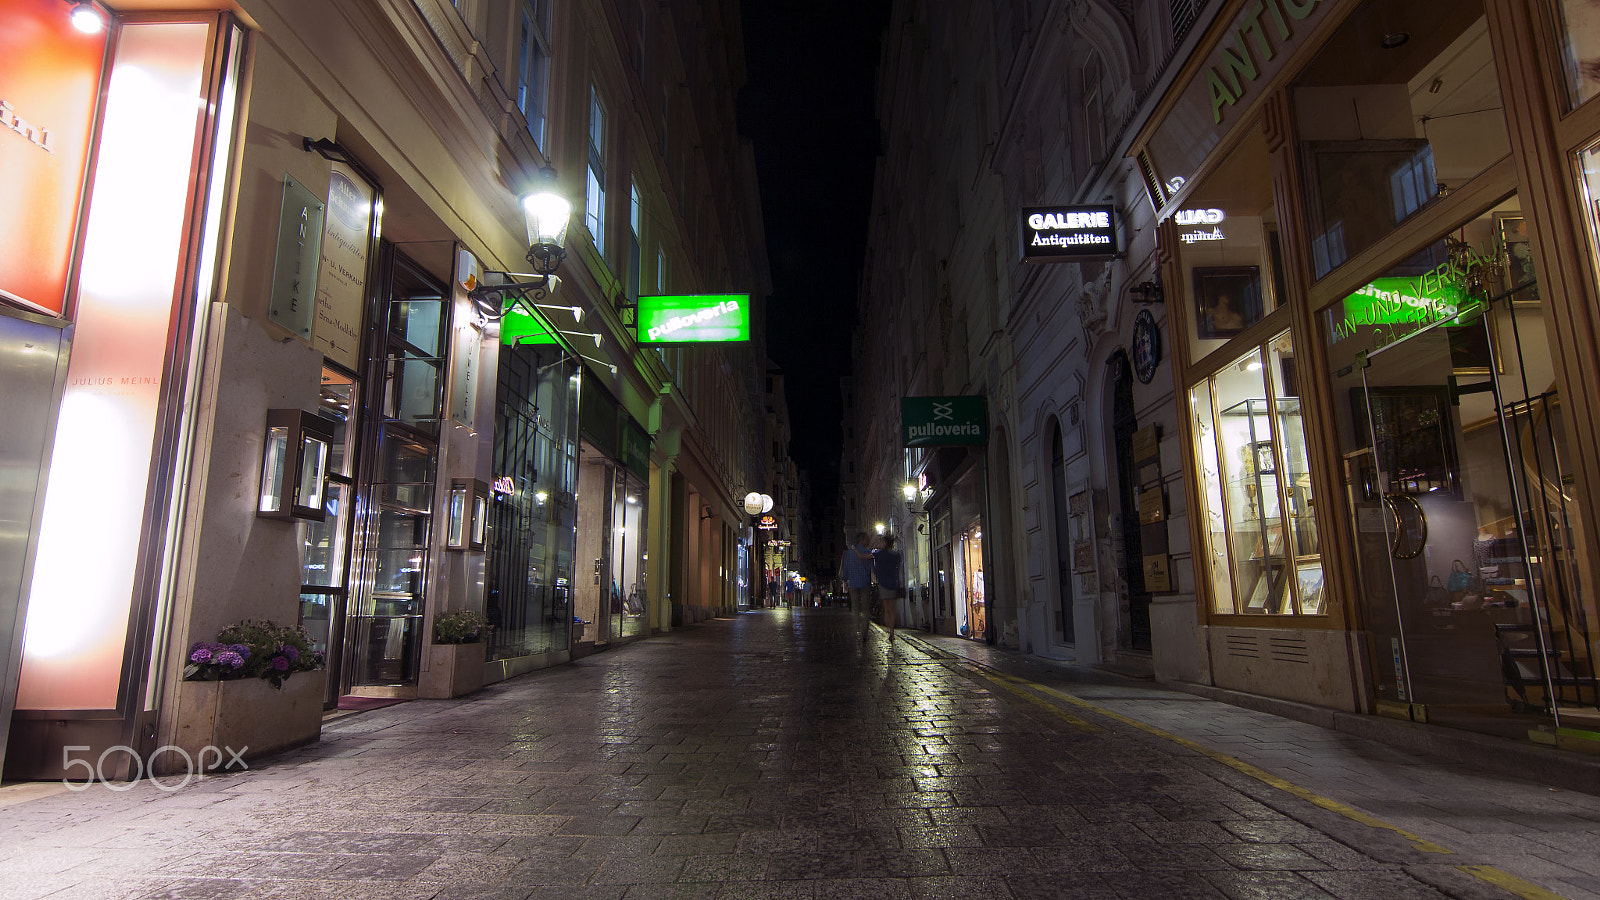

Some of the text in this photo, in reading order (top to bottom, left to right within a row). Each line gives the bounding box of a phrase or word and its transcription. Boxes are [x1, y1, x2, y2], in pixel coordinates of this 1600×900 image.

[1028, 211, 1110, 230] GALERIE
[1031, 231, 1110, 248] Antiquitäten
[290, 206, 308, 313] ANTIKE
[647, 300, 740, 341] pulloveria
[72, 377, 158, 386] JULIUS MEINL
[908, 421, 981, 440] pulloveria
